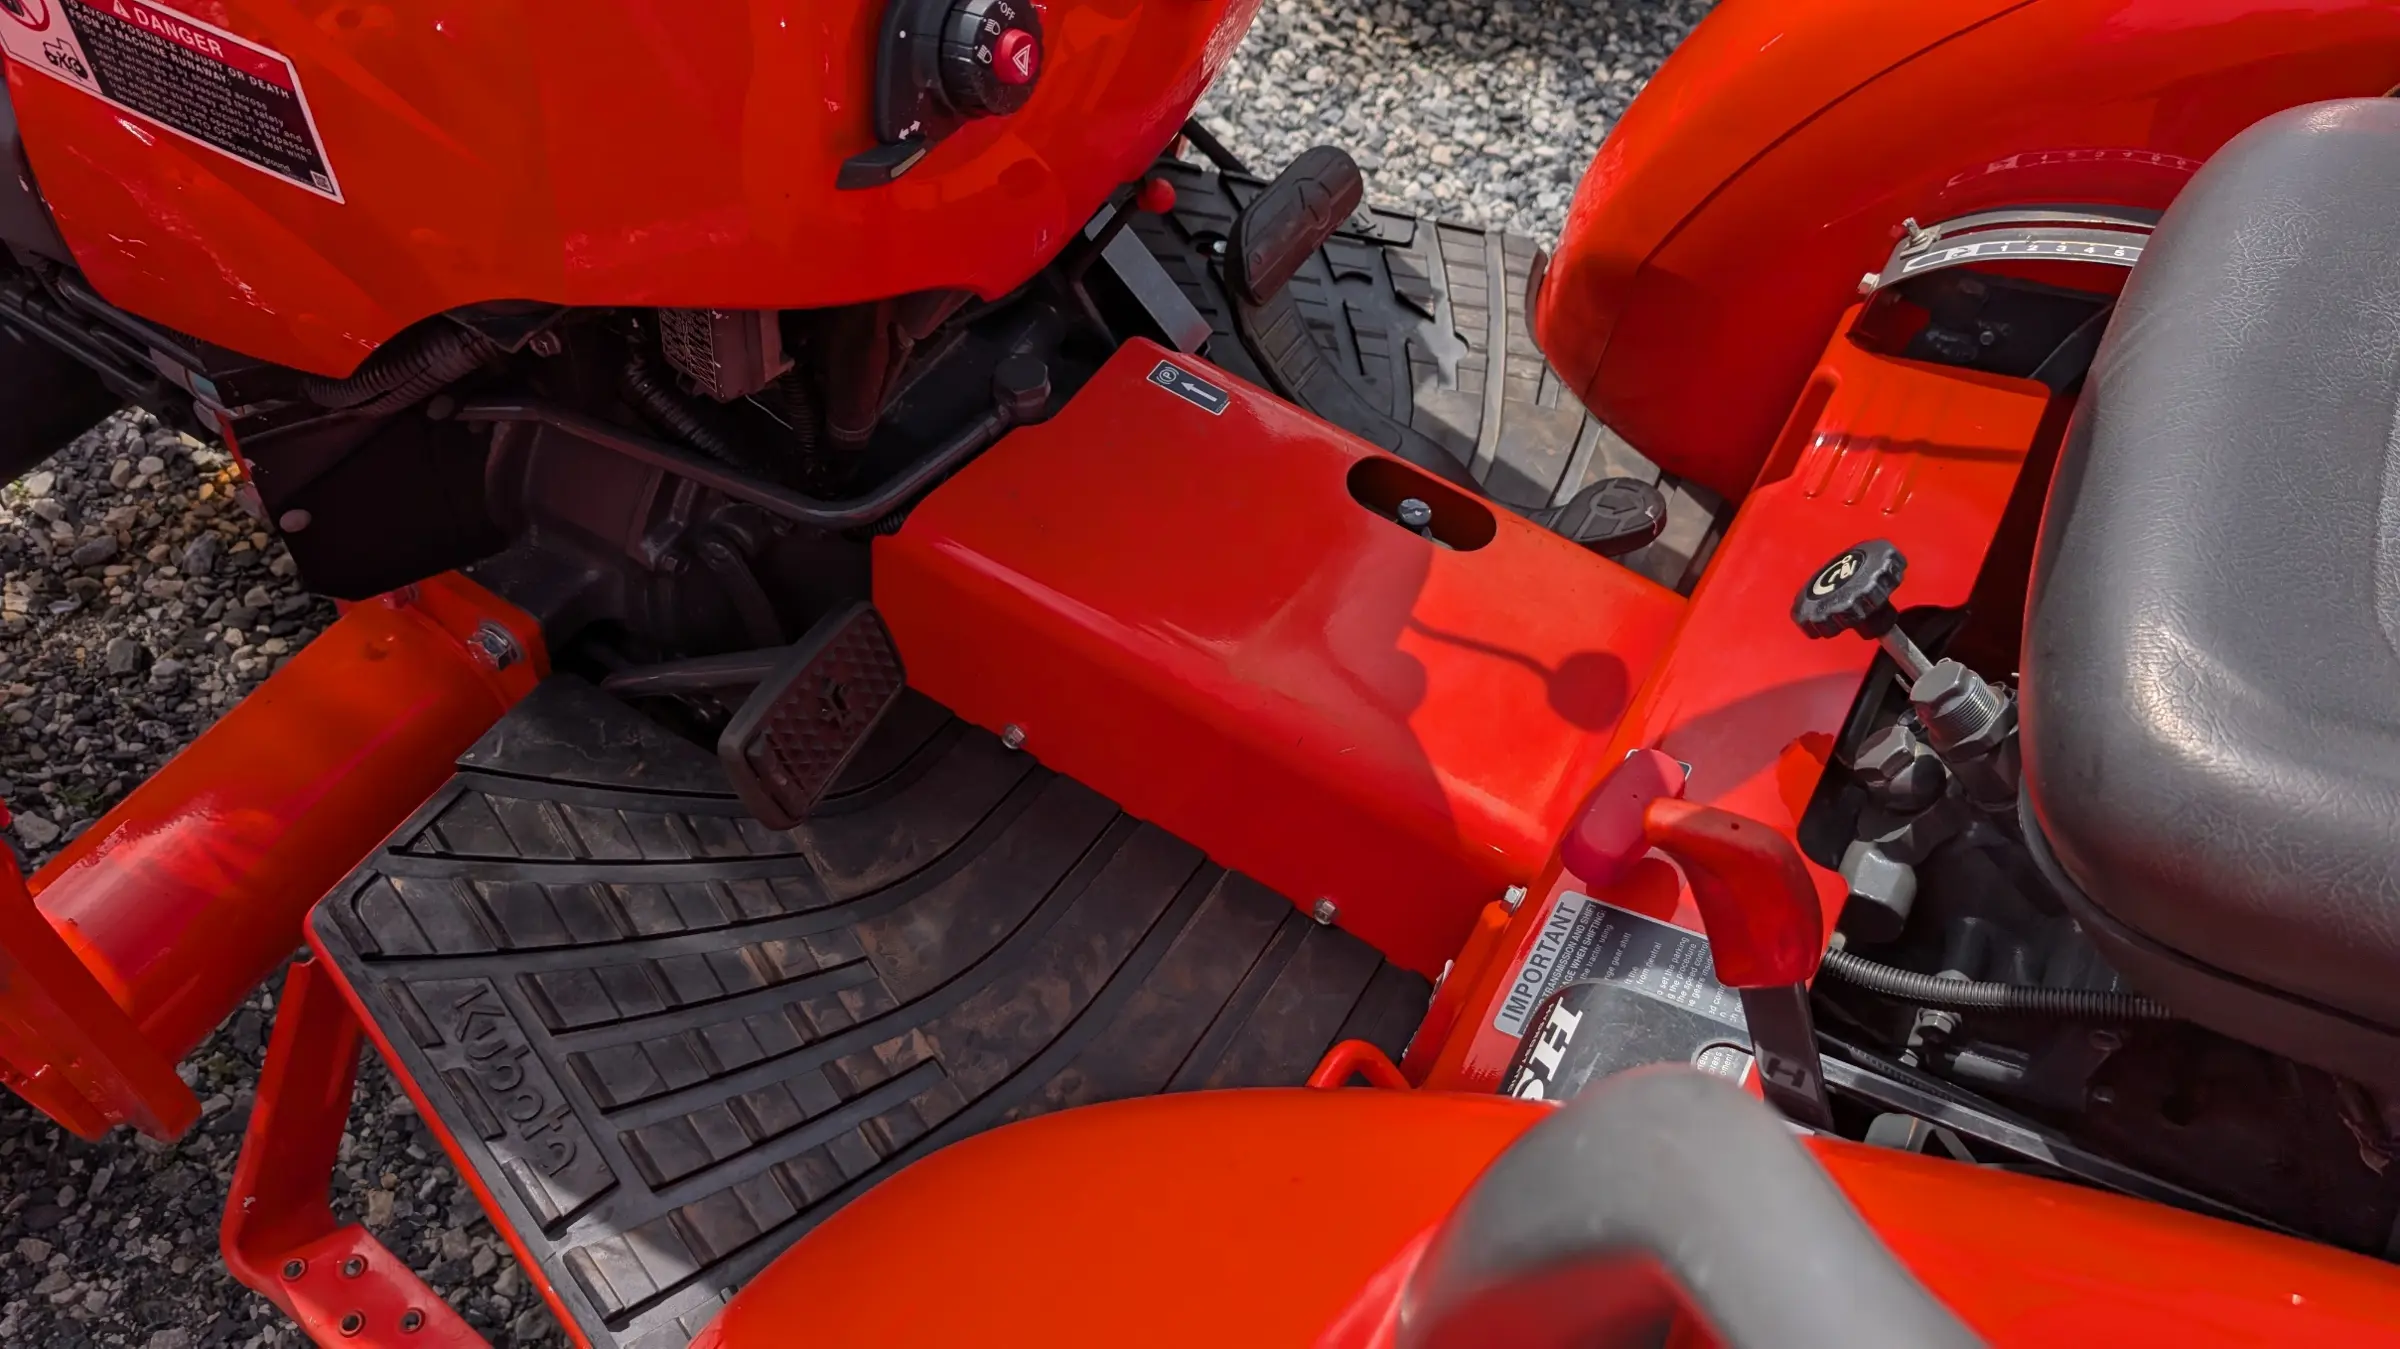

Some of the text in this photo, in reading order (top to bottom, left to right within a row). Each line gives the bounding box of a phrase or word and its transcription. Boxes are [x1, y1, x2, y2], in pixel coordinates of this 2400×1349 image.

[67, 7, 101, 29] FROM
[102, 22, 112, 34] A
[112, 27, 168, 58] MACHINE
[131, 6, 225, 57] DANGER
[999, 2, 1016, 21] OFF
[79, 4, 117, 27] AVOID
[118, 20, 178, 52] POSSIBLE
[178, 45, 225, 72] INJURY
[225, 65, 246, 81] OR
[246, 74, 290, 100] DEATH
[232, 90, 269, 112] across
[252, 108, 287, 130] safety
[281, 129, 304, 145] and
[2083, 246, 2095, 254] 4
[2114, 248, 2125, 257] 5
[1501, 900, 1578, 1022] IMPORTANT
[1541, 902, 1596, 998] TRANSMISSION AND SHIFT
[1570, 945, 1588, 969] WHEN
[1582, 909, 1607, 945] SHIFTING:
[1579, 923, 1615, 979] the tractor using
[1603, 932, 1632, 980] nge gear shift
[1636, 941, 1662, 984] from neutral
[1658, 976, 1670, 988] set
[1664, 963, 1675, 975] the
[1670, 936, 1691, 963] parking
[1627, 965, 1639, 977] the
[1668, 979, 1680, 992] the
[1675, 942, 1699, 979] procedure
[1675, 941, 1710, 1002] the speed control
[1691, 977, 1708, 998] gears
[455, 984, 578, 1178] Kubota
